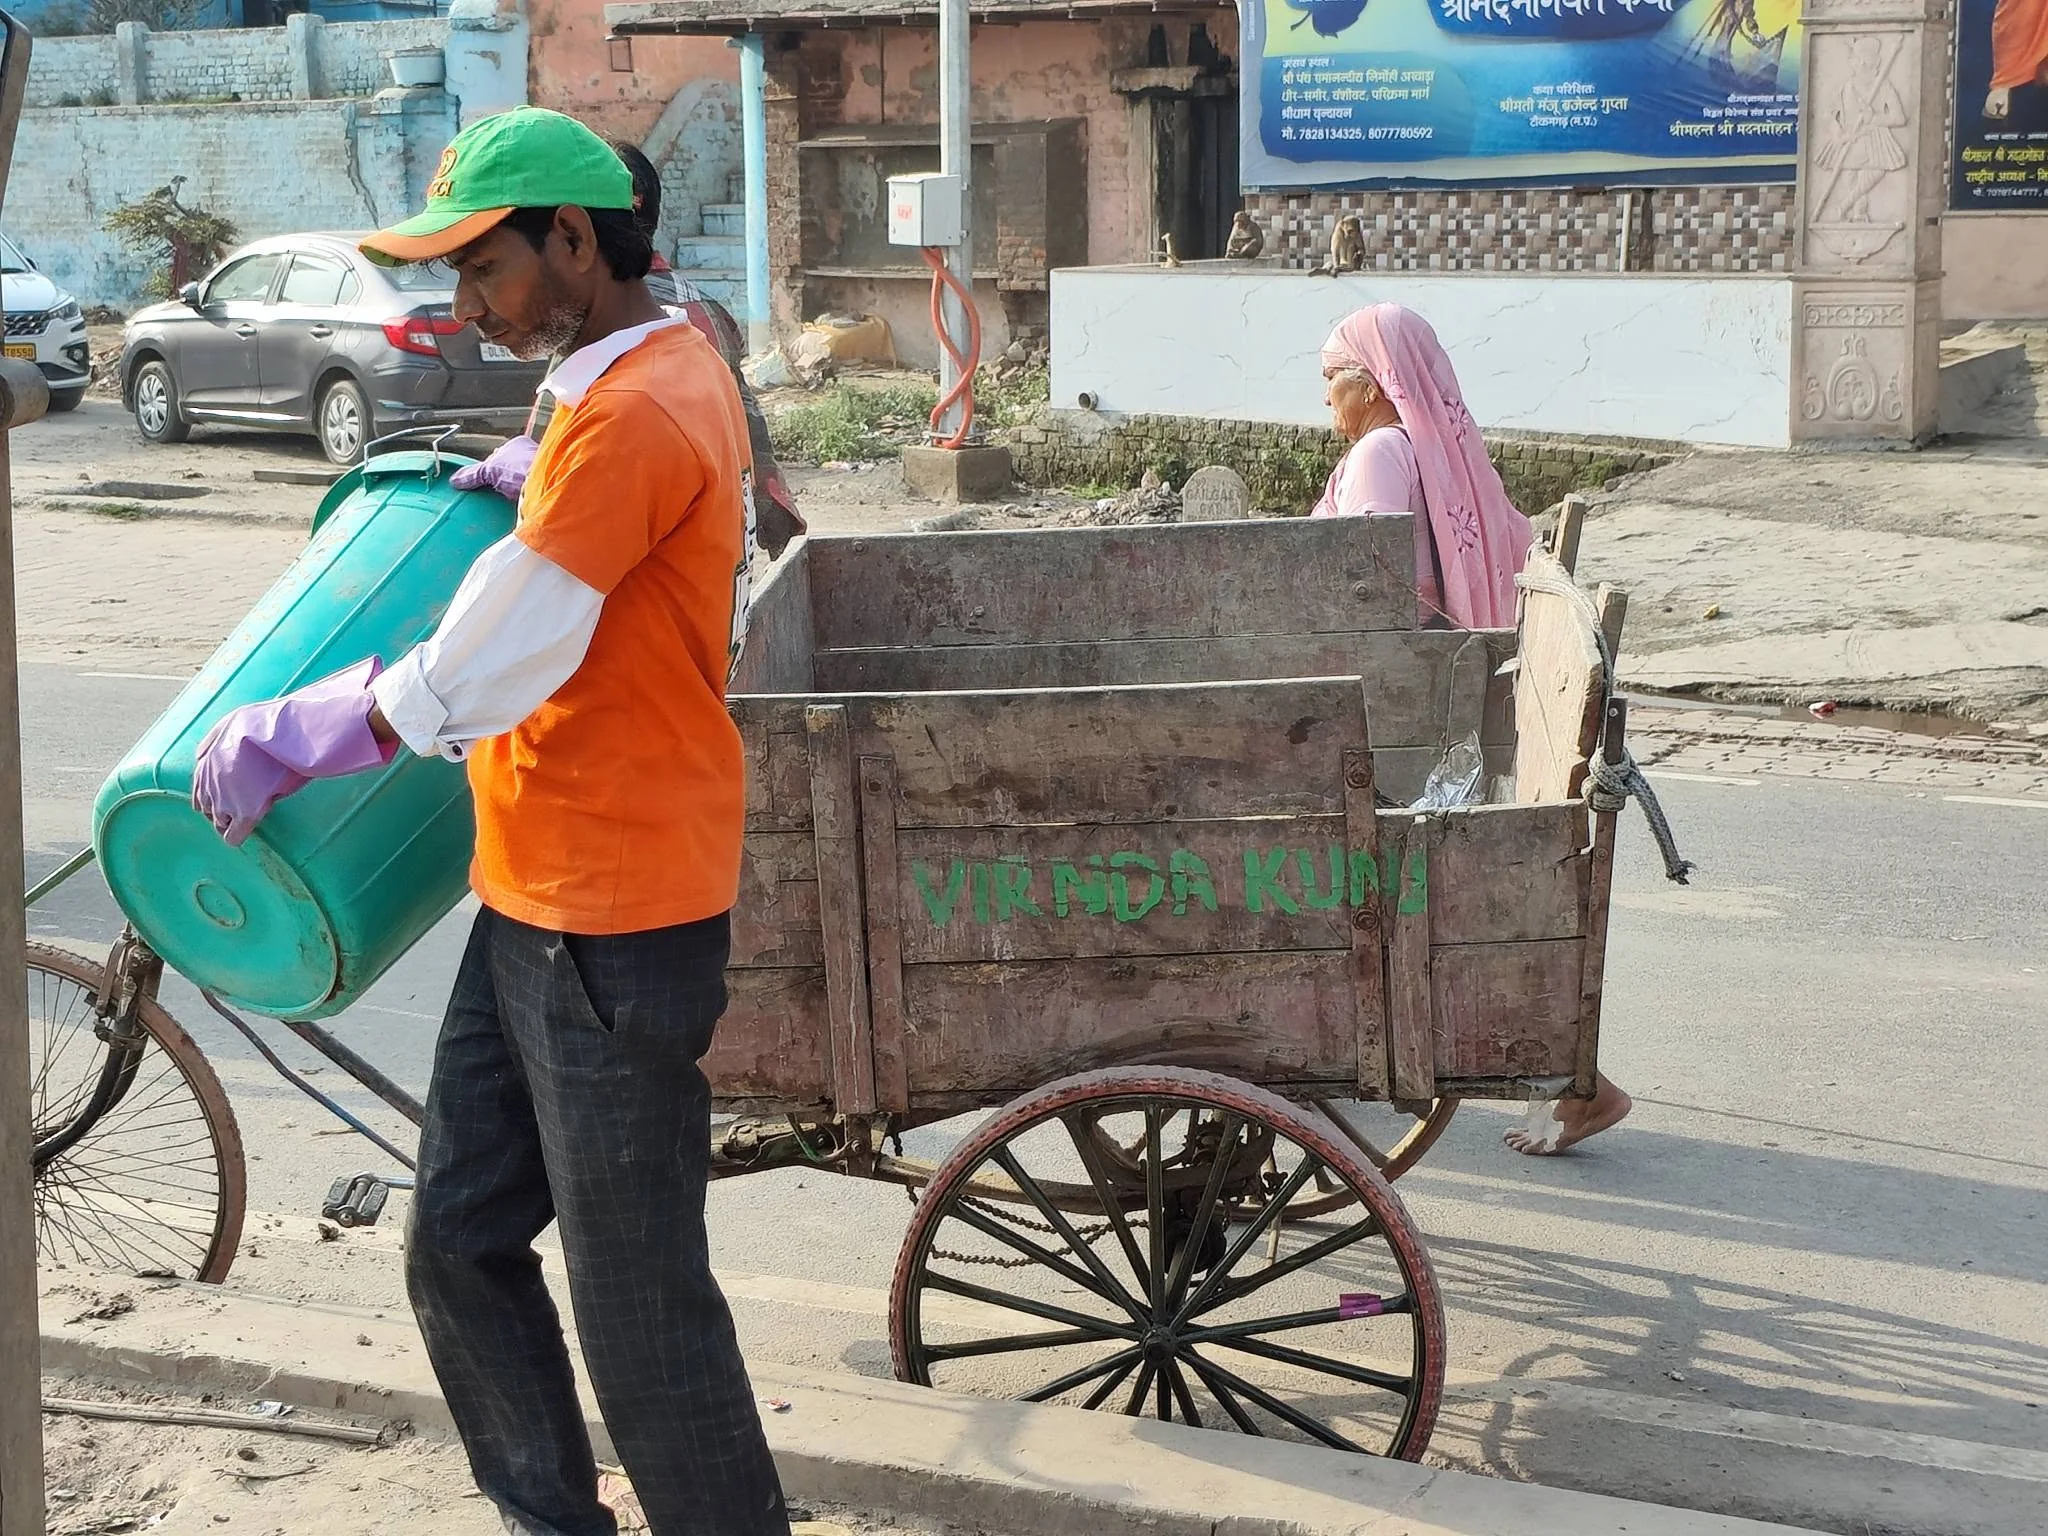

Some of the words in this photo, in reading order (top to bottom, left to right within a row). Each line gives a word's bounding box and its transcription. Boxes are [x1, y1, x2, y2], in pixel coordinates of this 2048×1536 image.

[1500, 97, 1535, 113] श्रीमती
[1600, 97, 1628, 114] गुप्ता
[1299, 128, 1366, 140] 7828134325,
[1368, 127, 1433, 140] 8077780592
[1718, 119, 1734, 136] श्री
[911, 848, 1218, 928] VIRNDA
